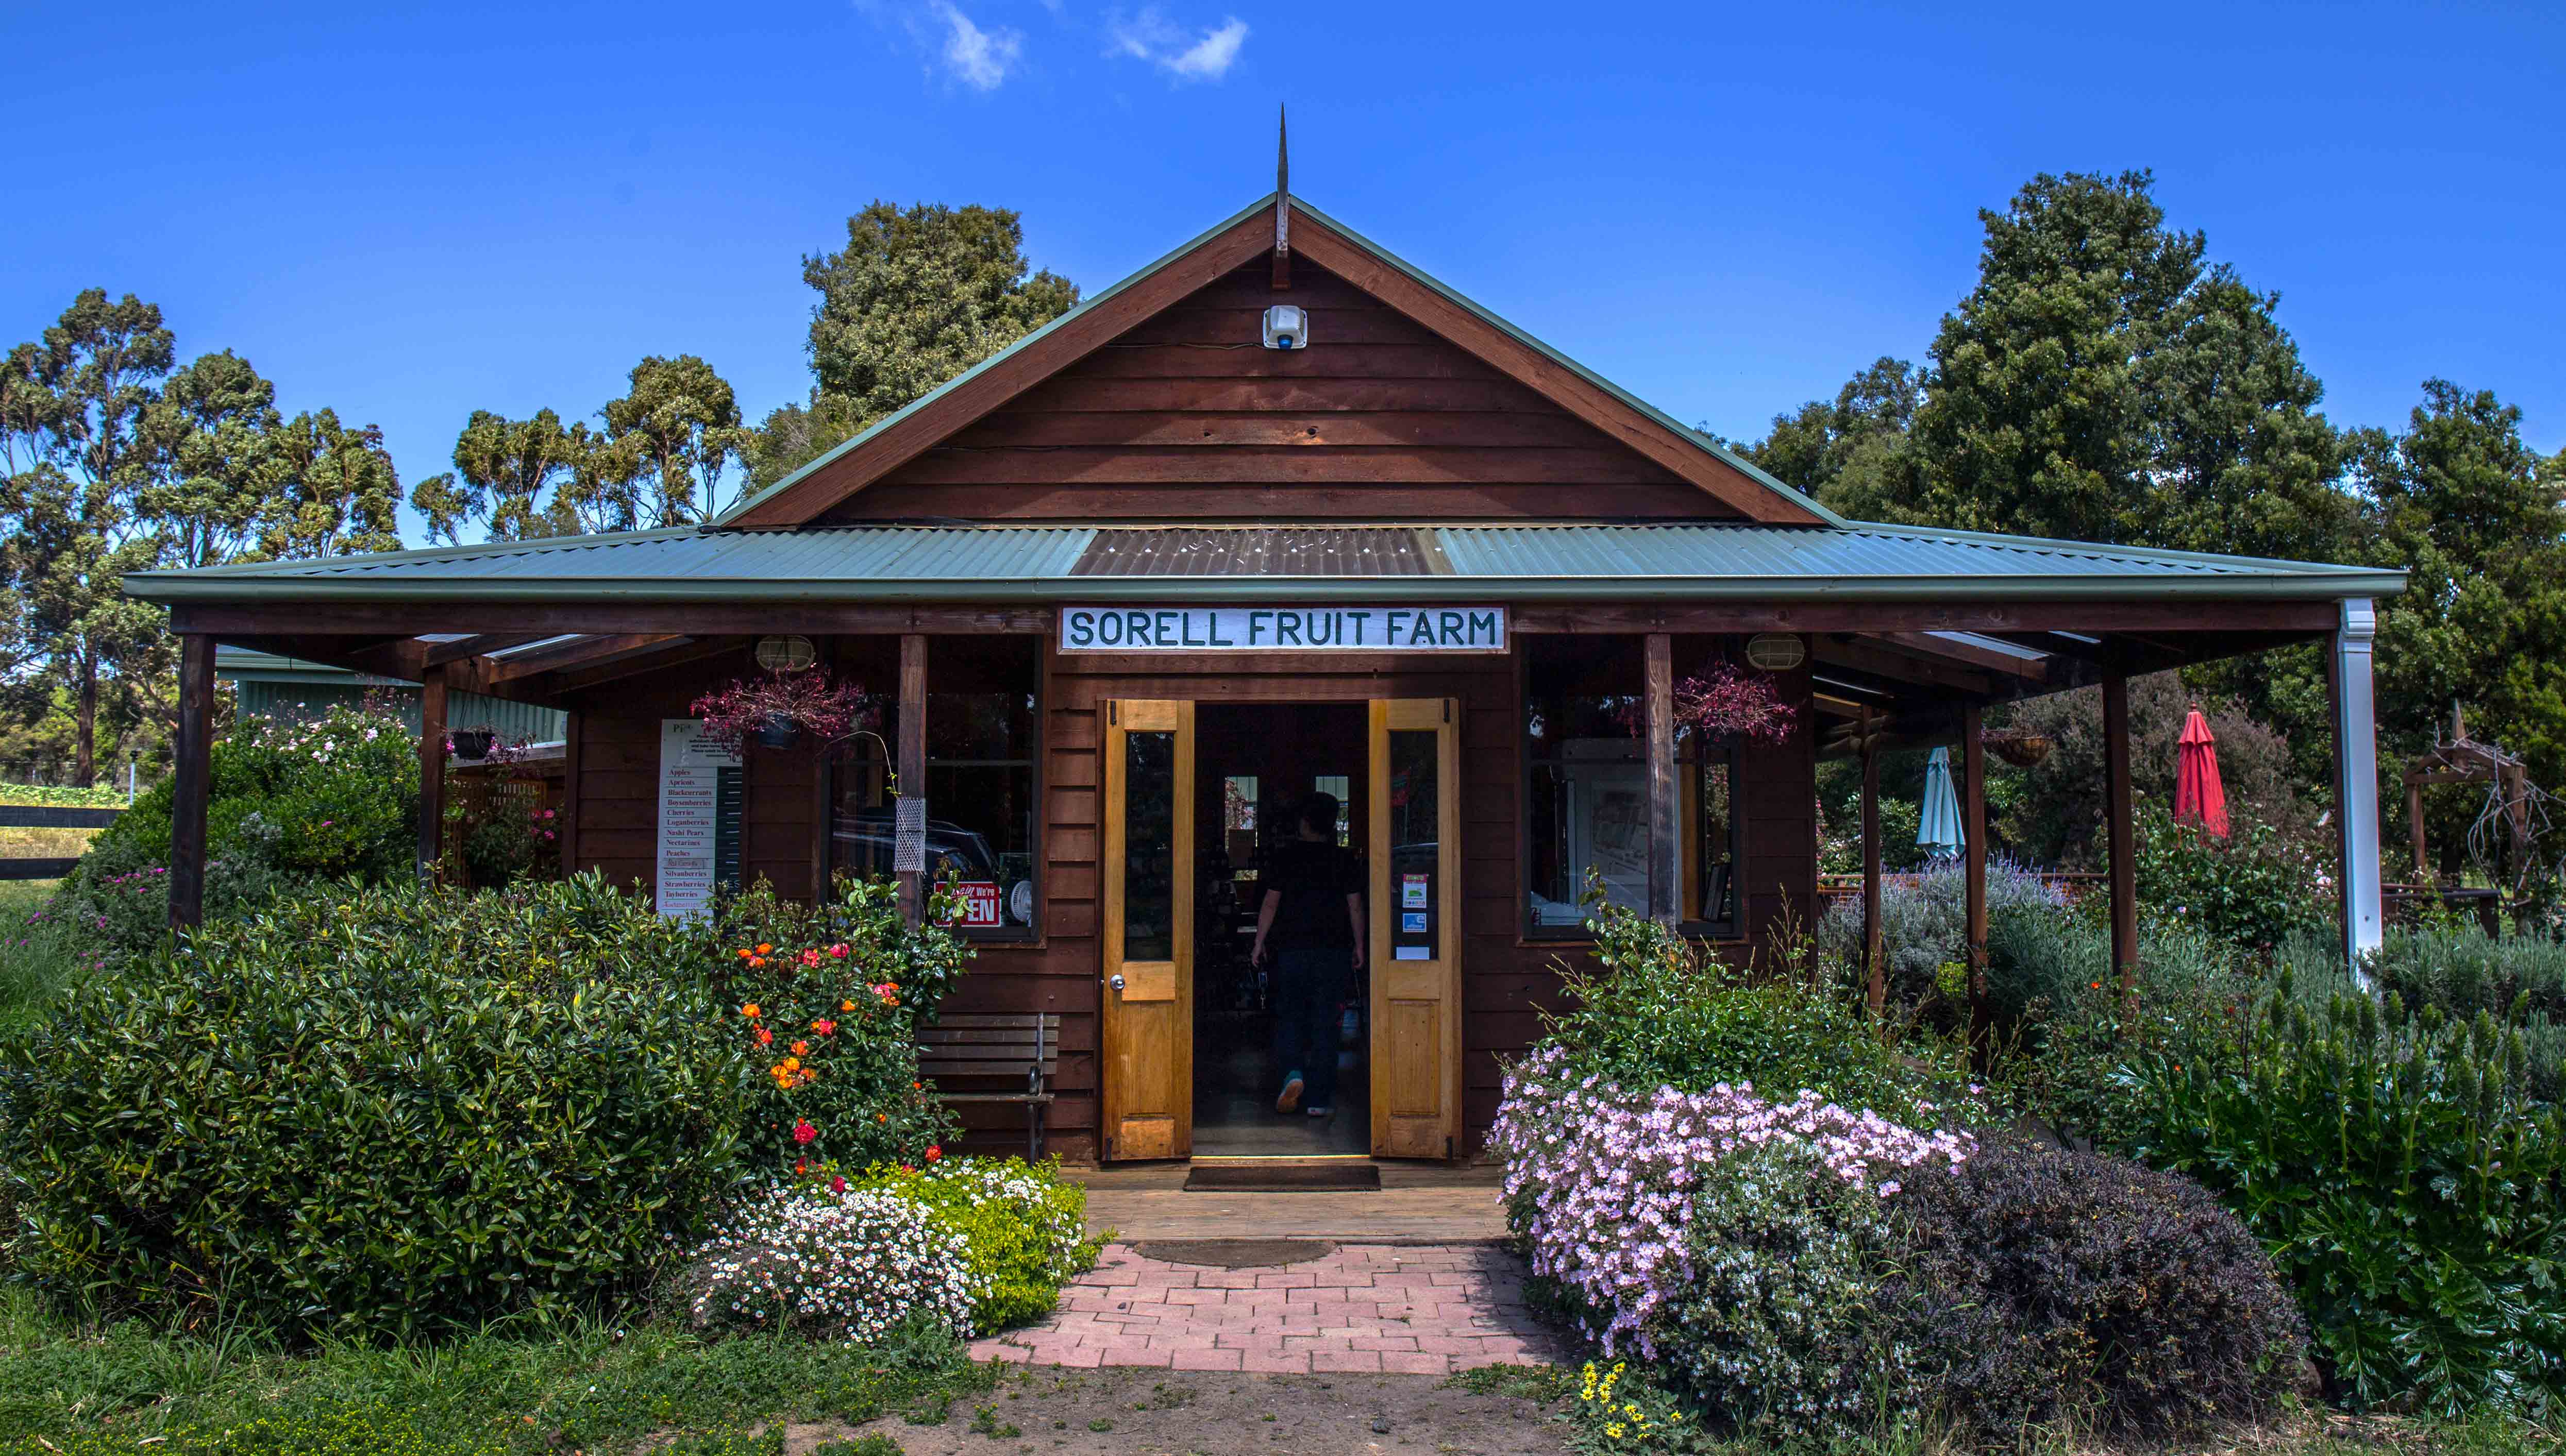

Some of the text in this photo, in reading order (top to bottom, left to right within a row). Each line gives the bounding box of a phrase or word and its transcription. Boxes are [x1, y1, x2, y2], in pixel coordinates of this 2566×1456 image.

[1070, 611, 1495, 646] SORELL FRUIT FARM
[977, 887, 995, 896] We're
